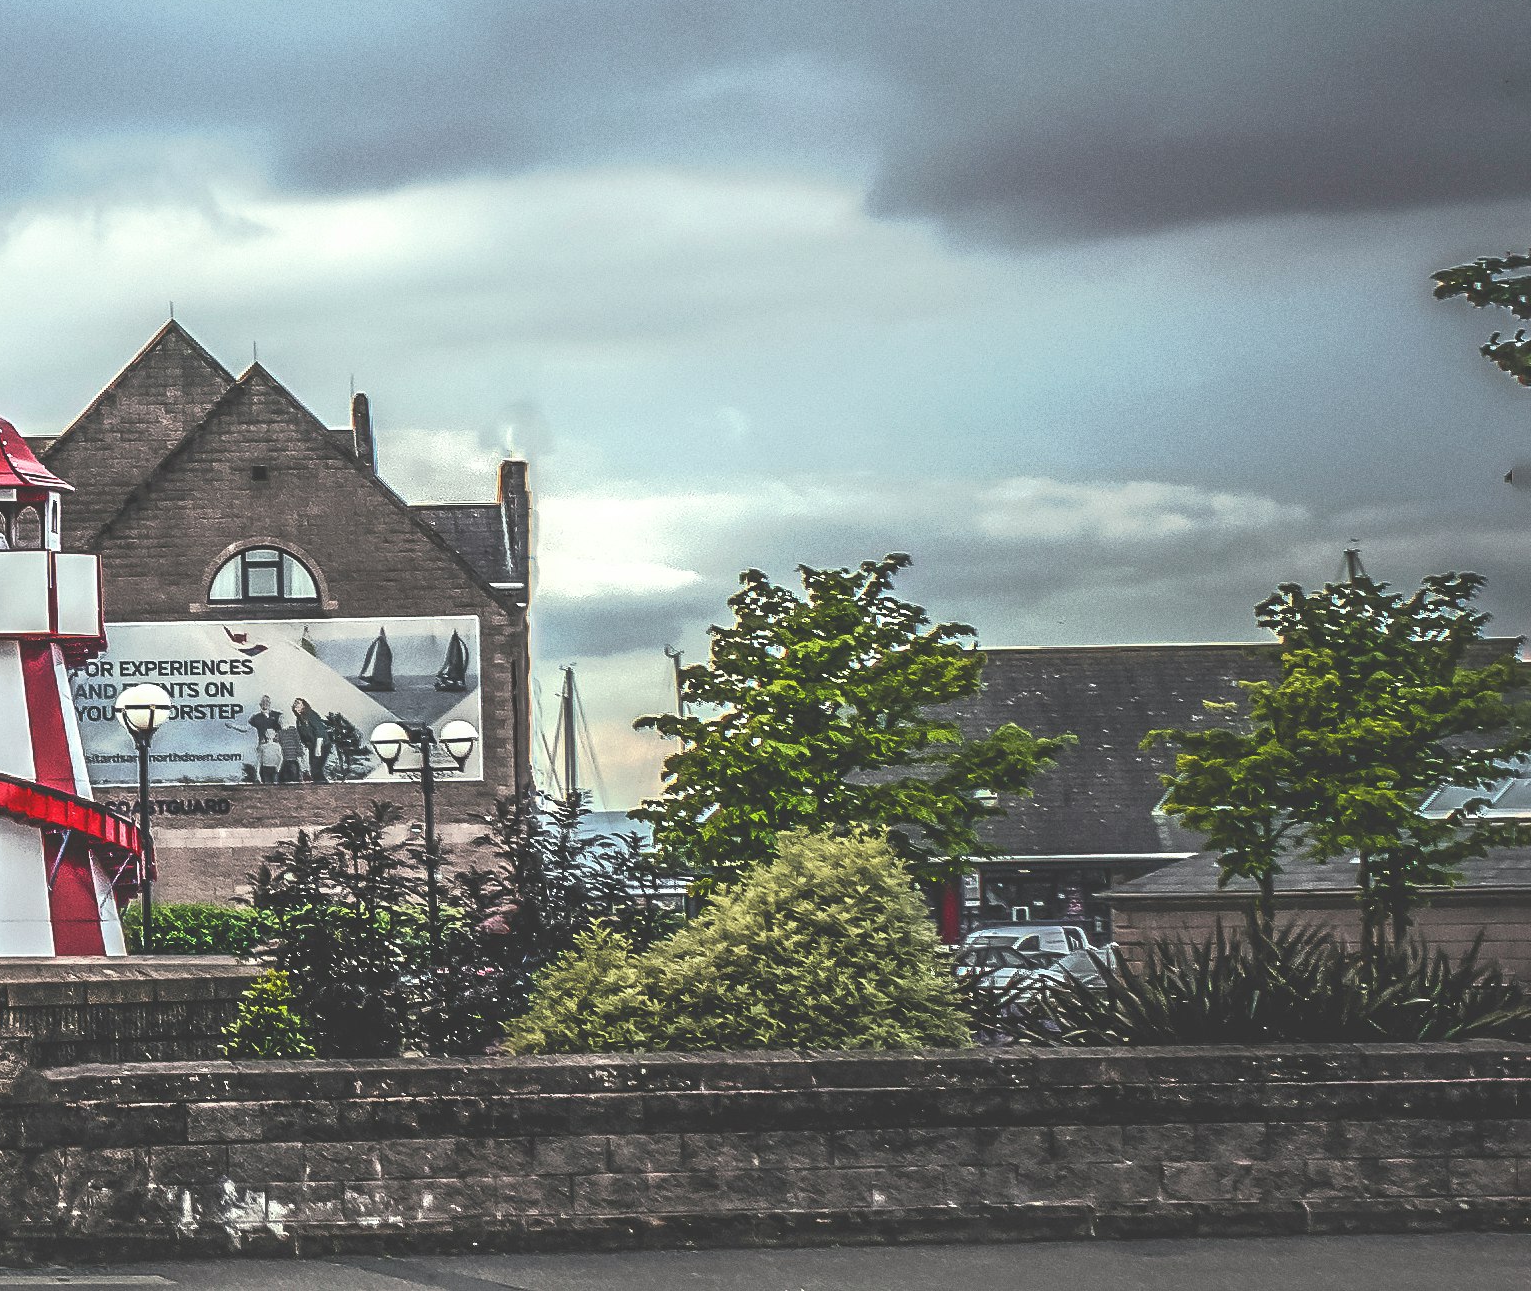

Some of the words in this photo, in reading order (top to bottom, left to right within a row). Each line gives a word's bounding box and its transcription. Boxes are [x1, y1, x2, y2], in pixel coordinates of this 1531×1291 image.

[119, 659, 254, 677] EXPERIENCES
[75, 683, 118, 699] AND
[204, 681, 235, 698] ON
[75, 705, 116, 723] YOU
